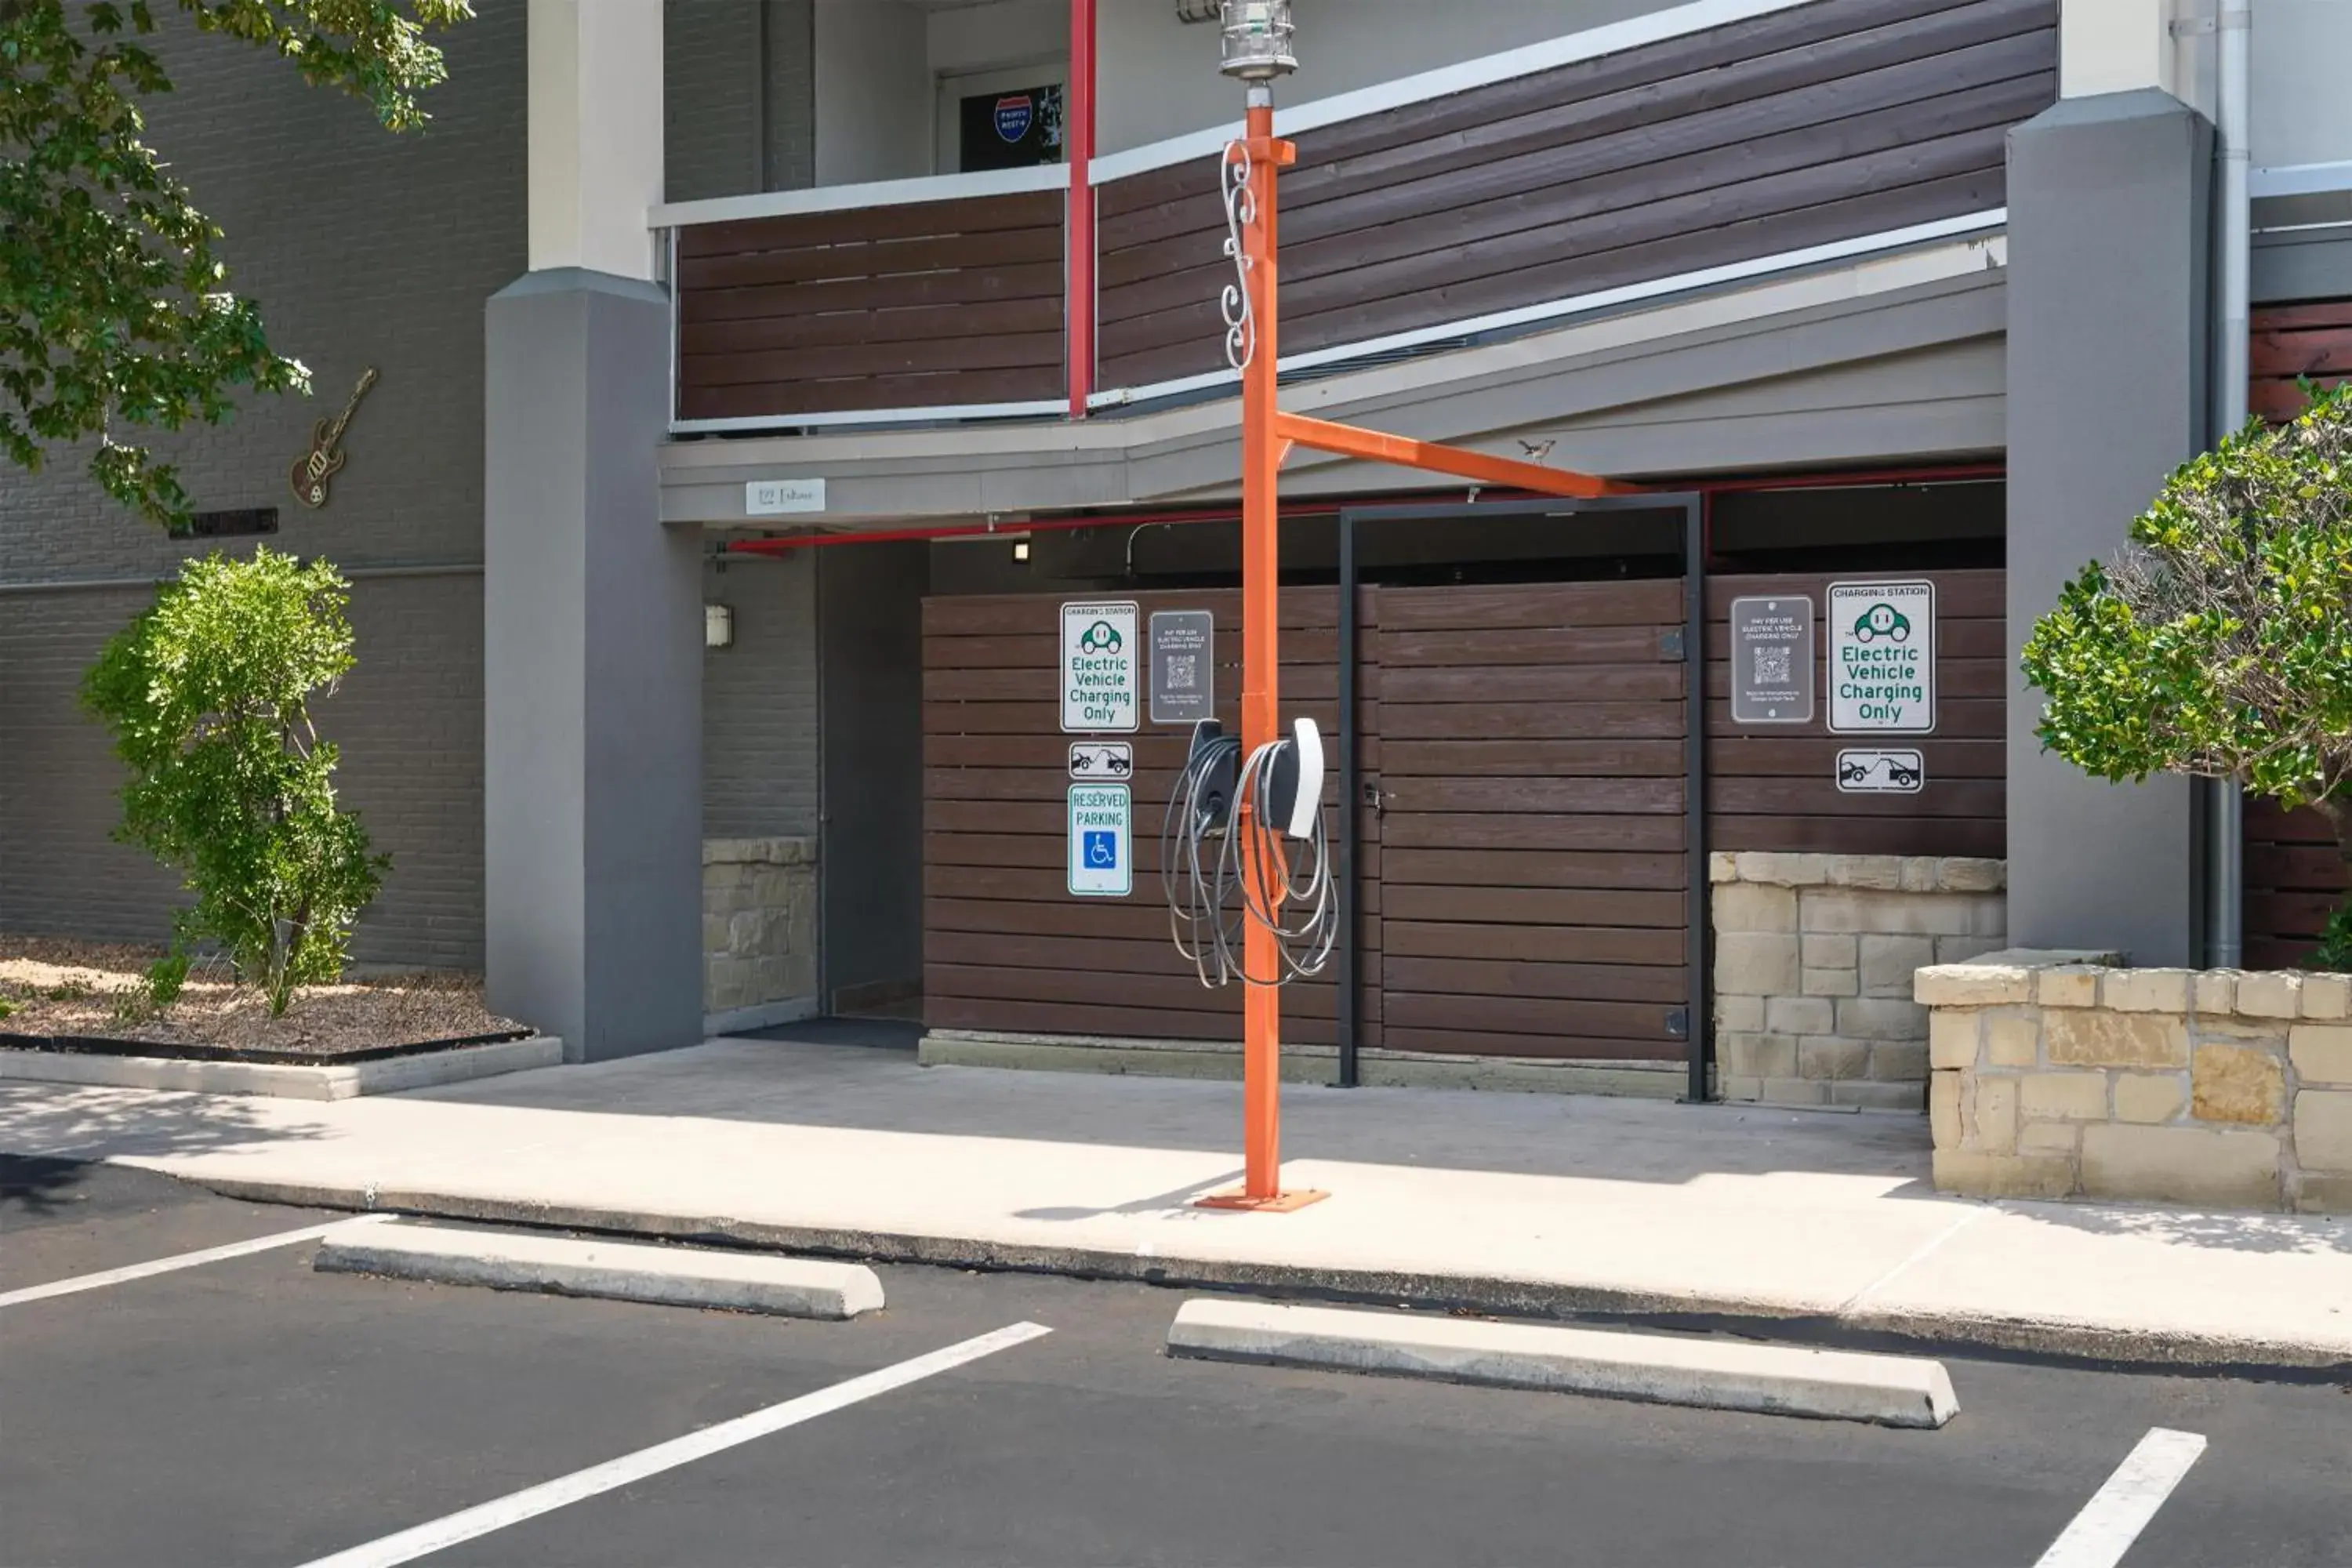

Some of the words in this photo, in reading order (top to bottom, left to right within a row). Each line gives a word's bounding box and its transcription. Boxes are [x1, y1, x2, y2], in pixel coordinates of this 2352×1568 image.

[1834, 589, 1886, 597] CHARGING
[1887, 587, 1927, 597] STATION
[1842, 645, 1918, 662] Electric
[1072, 657, 1127, 670] Electric
[1075, 672, 1125, 686] Vehicle
[1846, 664, 1915, 680] Vehicle
[1070, 689, 1131, 706] Charging
[1840, 683, 1922, 703] Charging
[1084, 706, 1115, 723] Only
[1859, 703, 1902, 723] Only
[1073, 793, 1125, 808] RESERVED
[1076, 812, 1123, 826] PARKING
